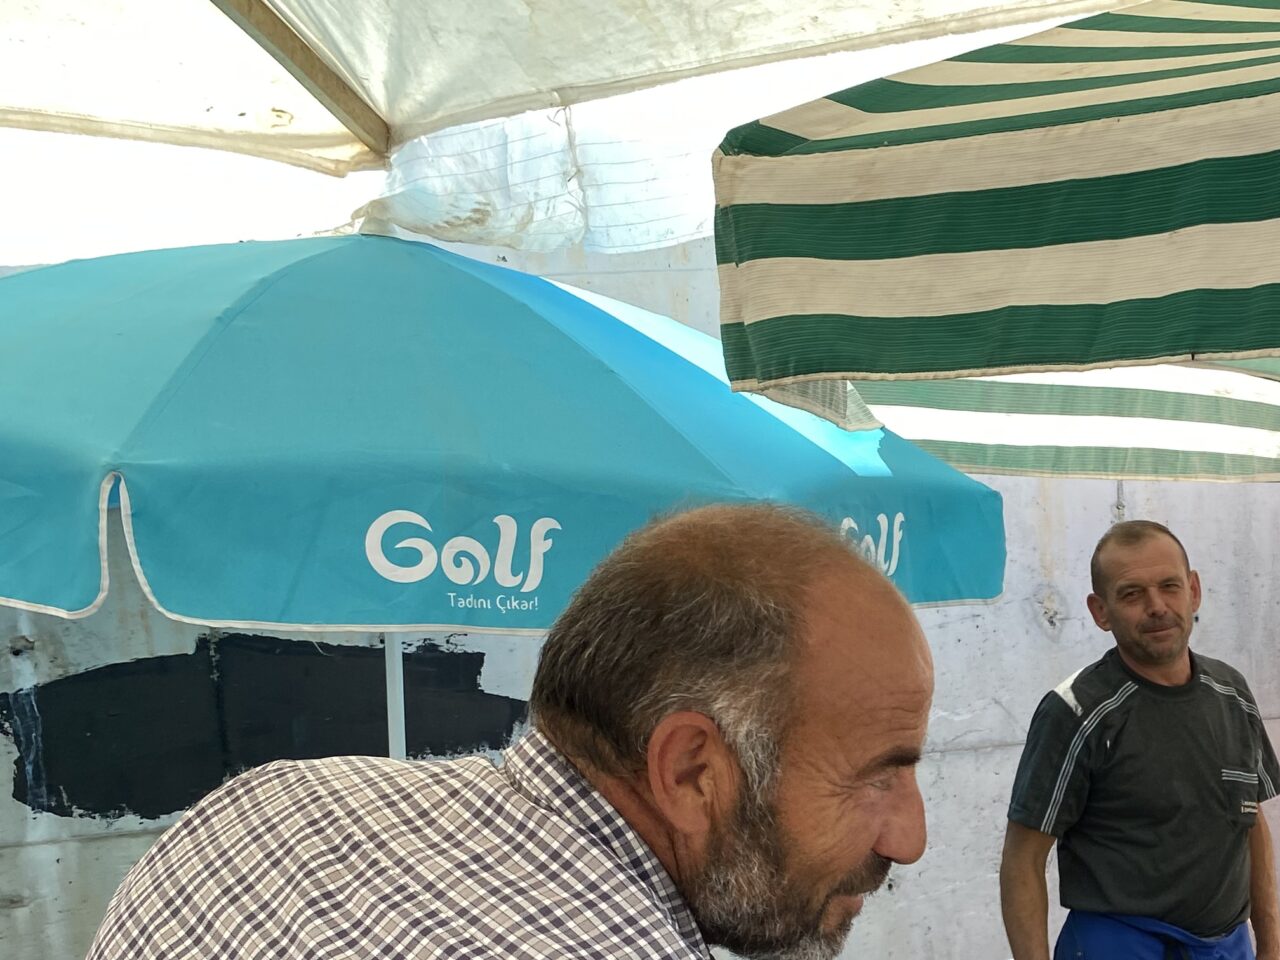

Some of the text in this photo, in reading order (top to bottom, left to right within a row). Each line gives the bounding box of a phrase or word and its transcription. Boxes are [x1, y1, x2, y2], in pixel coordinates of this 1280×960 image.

[365, 510, 562, 593] Golf
[447, 592, 539, 613] Tadını Çıkar!
